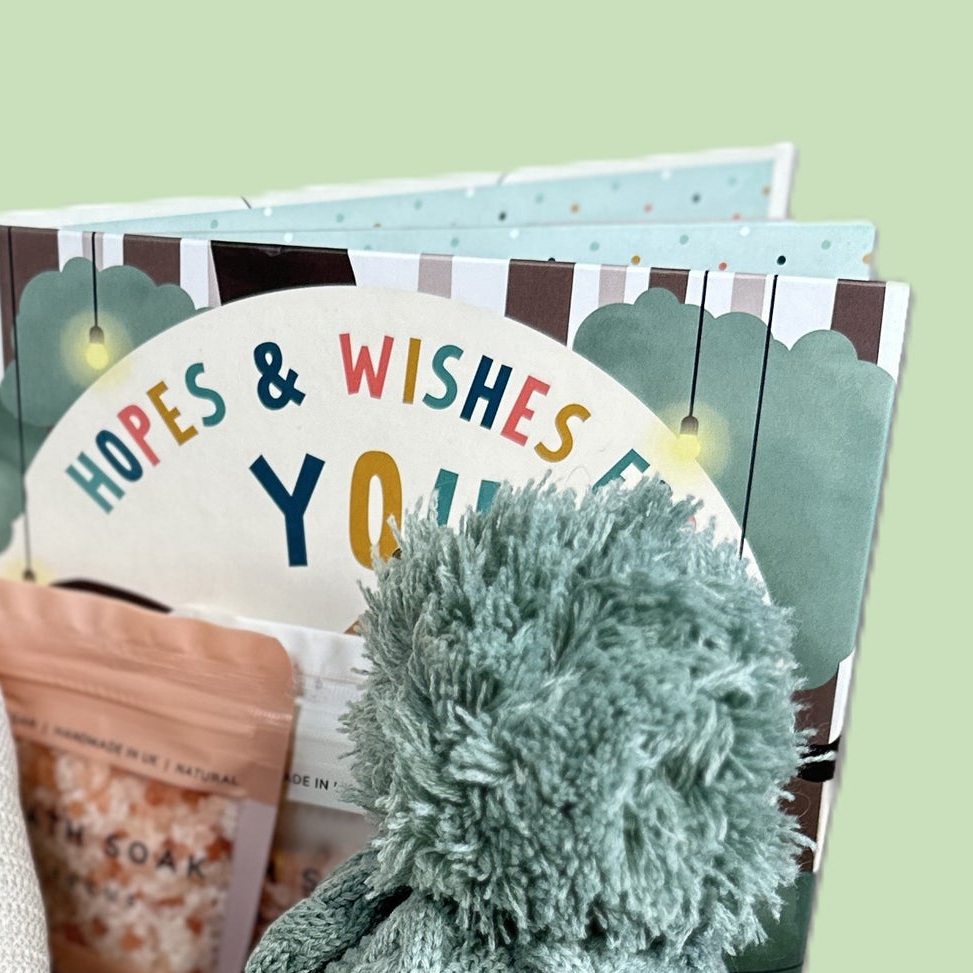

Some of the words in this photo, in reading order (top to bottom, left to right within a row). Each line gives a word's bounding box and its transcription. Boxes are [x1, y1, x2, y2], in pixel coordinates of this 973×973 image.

[65, 362, 226, 515] HOPES
[253, 341, 307, 411] &
[339, 333, 592, 463] WISHES
[175, 763, 238, 786] NATURAL
[315, 778, 329, 790] IN
[103, 834, 207, 879] SOAK
